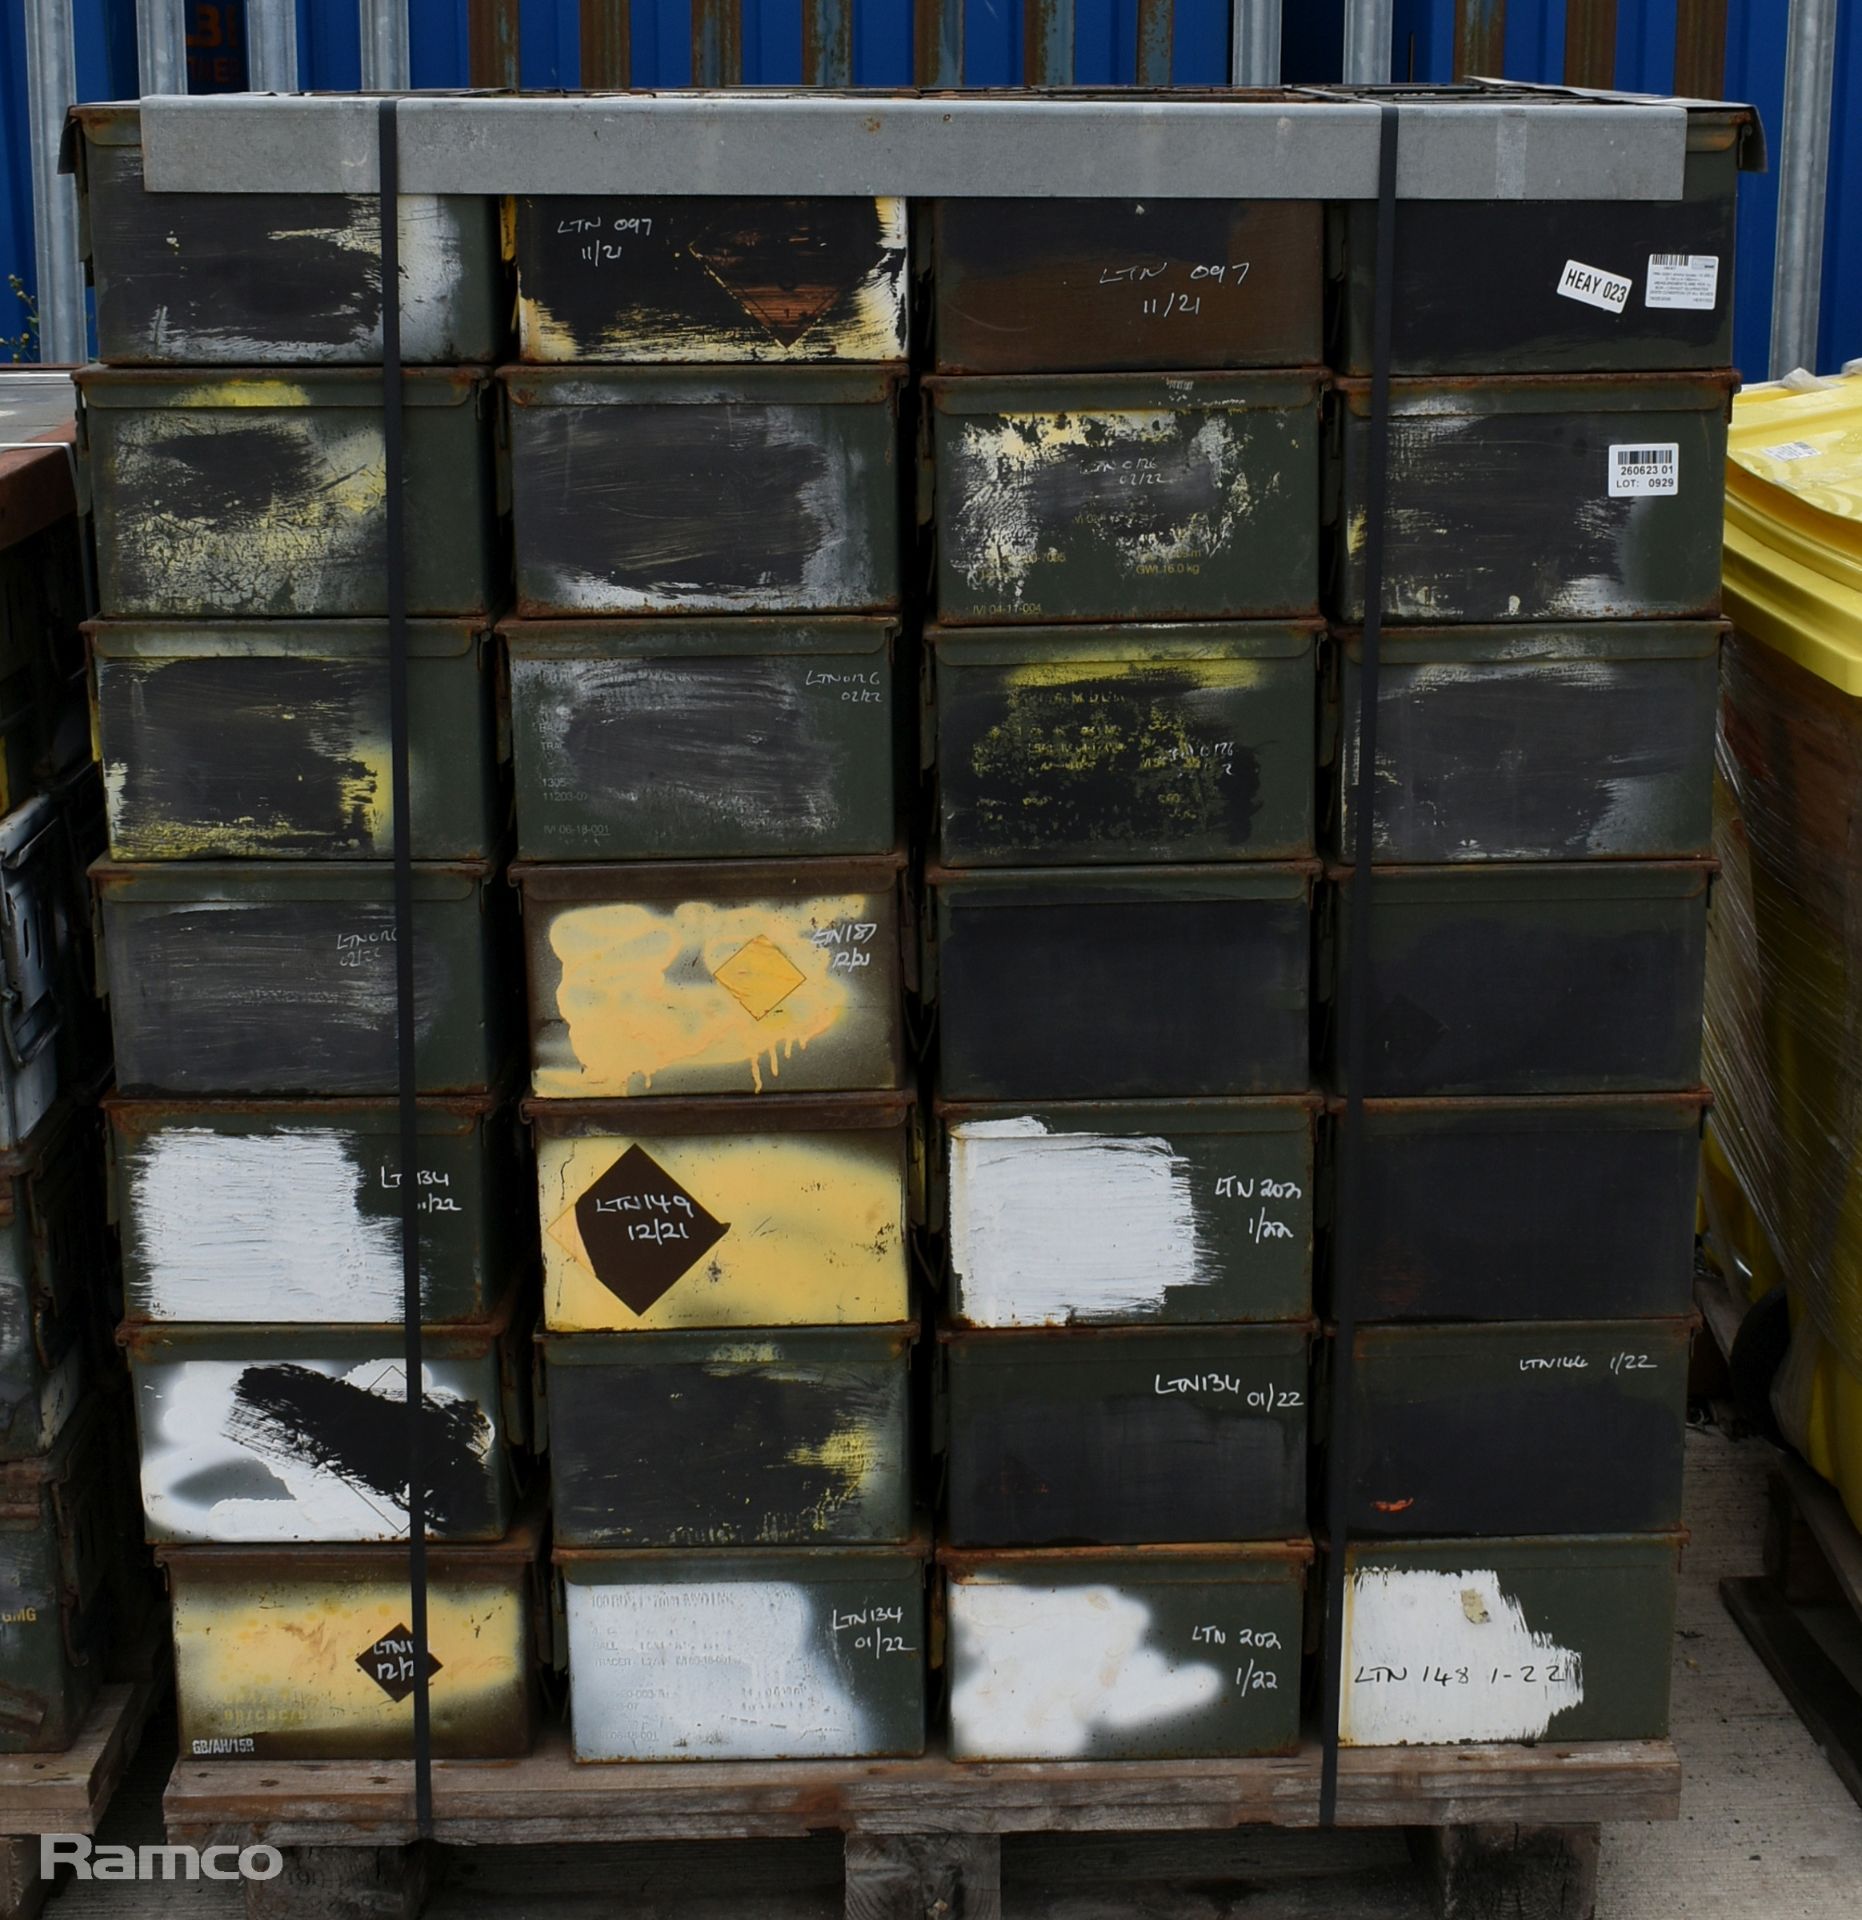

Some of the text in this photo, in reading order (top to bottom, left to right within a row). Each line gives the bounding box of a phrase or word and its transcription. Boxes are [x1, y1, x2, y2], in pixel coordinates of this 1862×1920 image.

[557, 217, 652, 236] LTN 097
[581, 240, 622, 267] 11/21
[1099, 262, 1250, 285] LTN 097
[1565, 268, 1627, 303] HEAY 023
[1143, 292, 1200, 318] 11/21
[1616, 478, 1674, 488] LOT: 0929
[1620, 465, 1673, 476] 260623 01
[381, 1166, 450, 1188] LT134
[1215, 1175, 1254, 1198] LTN
[596, 1193, 694, 1218] LTN149
[627, 1218, 689, 1245] 12/21
[1248, 1206, 1294, 1244] 1/22
[1609, 1352, 1658, 1375] 1/22
[1155, 1374, 1304, 1412] LTN134 01/22
[833, 1606, 904, 1630] LTN134
[855, 1627, 917, 1659] 01/22
[1192, 1625, 1281, 1650] LTN 202
[377, 1656, 414, 1681] 12/2
[1236, 1658, 1278, 1697] 1/22
[1354, 1666, 1408, 1683] LTN
[1422, 1665, 1470, 1687] 148
